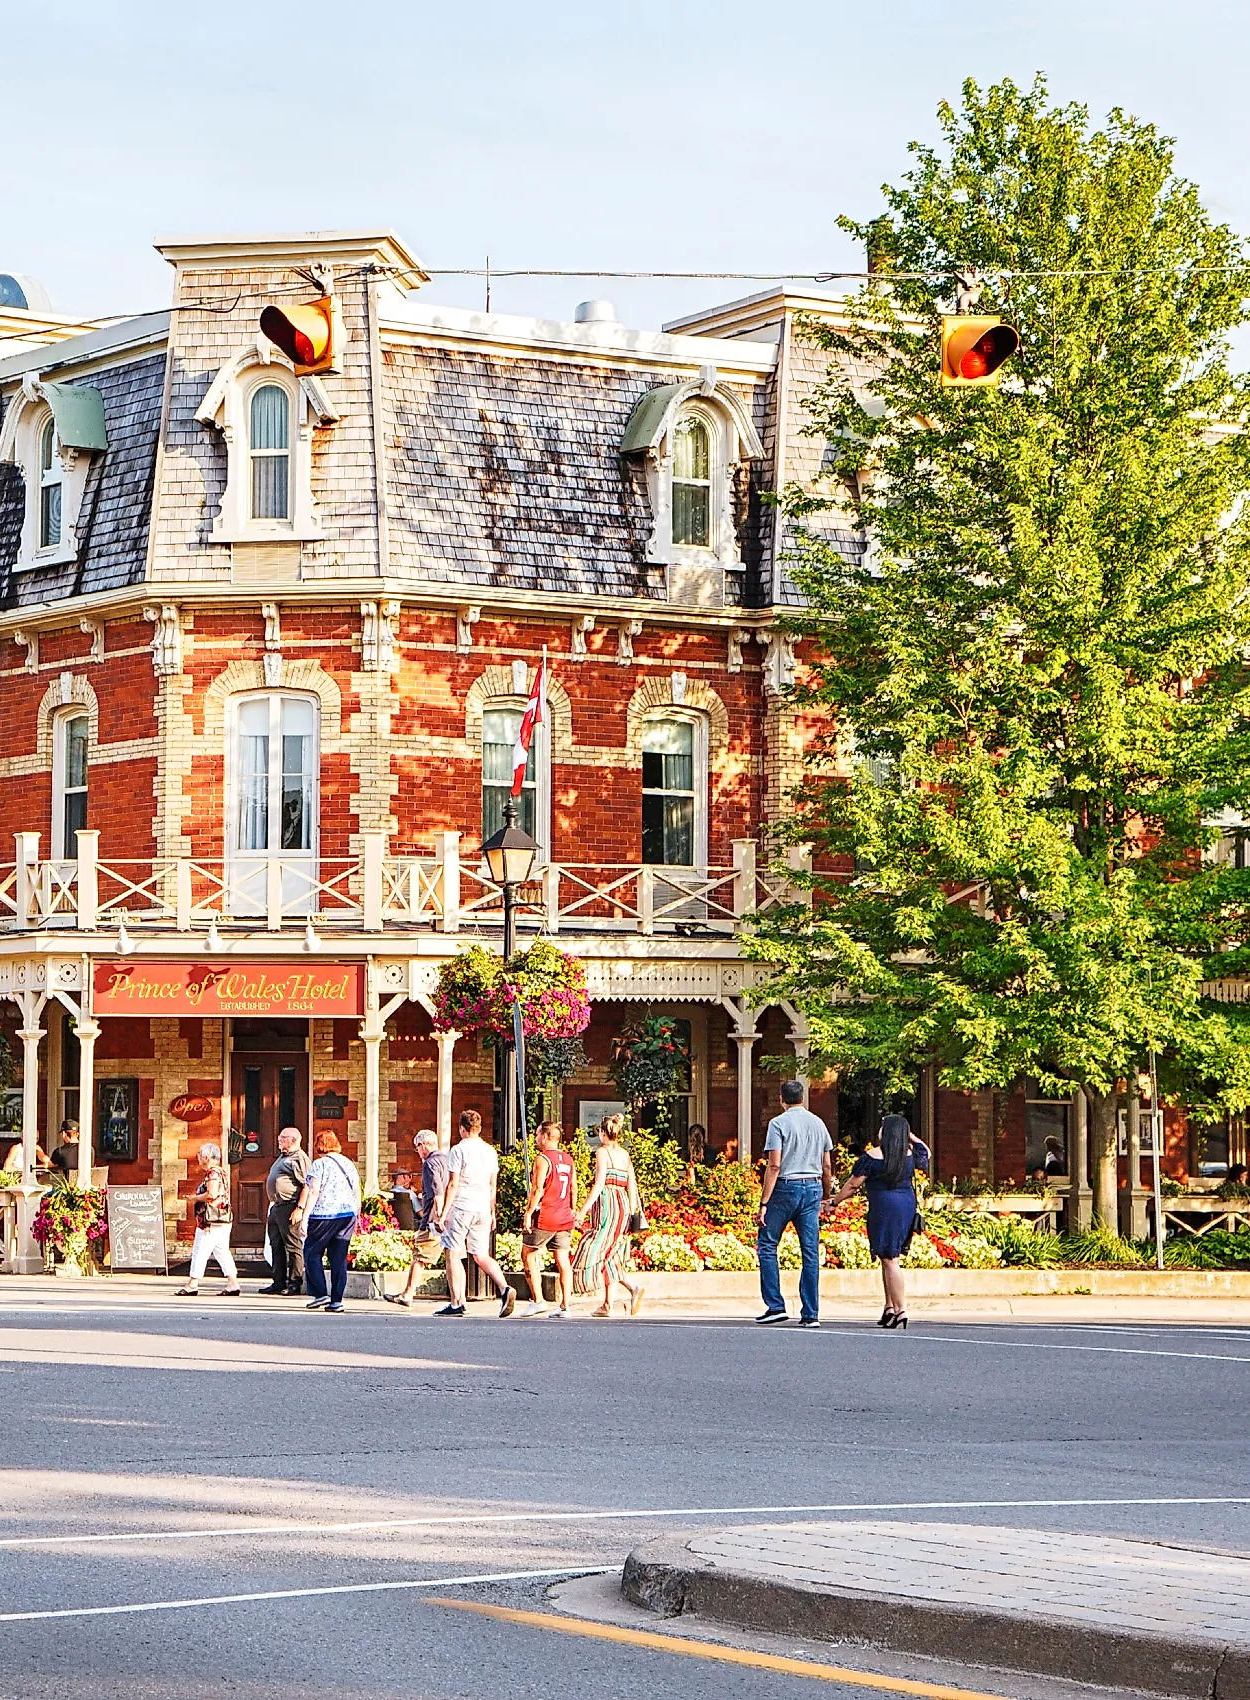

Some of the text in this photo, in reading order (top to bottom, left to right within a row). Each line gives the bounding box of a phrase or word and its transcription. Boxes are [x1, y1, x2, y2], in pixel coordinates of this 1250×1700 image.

[108, 973, 182, 999] Prince
[185, 973, 215, 1006] of
[287, 974, 350, 1000] Hotel
[220, 1001, 314, 1011] ESTABLISHED 1864
[174, 1098, 209, 1117] Open
[559, 1175, 569, 1200] 7
